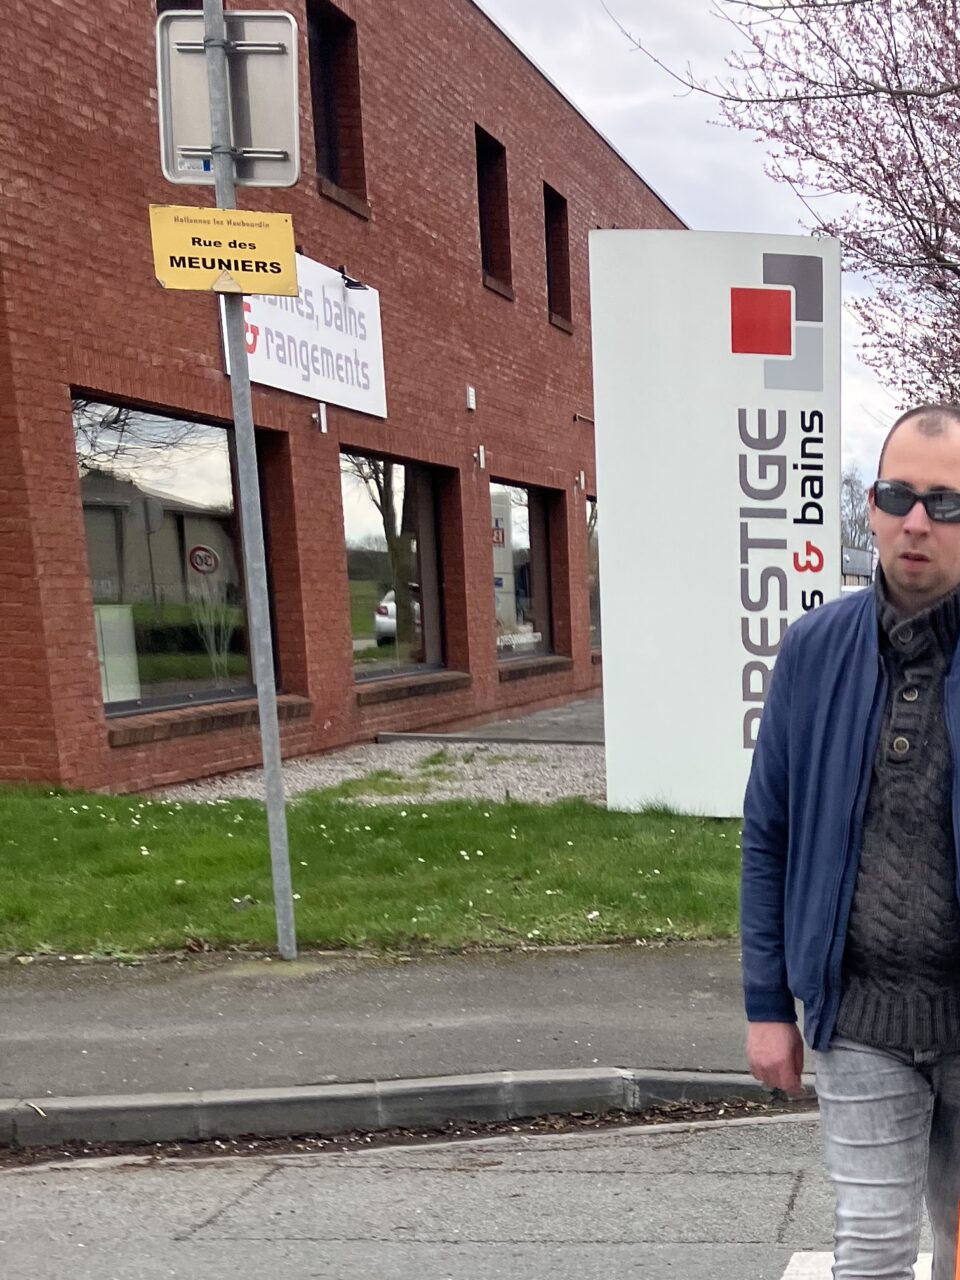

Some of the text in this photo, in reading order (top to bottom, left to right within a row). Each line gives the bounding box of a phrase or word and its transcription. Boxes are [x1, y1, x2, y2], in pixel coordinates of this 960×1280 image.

[169, 255, 282, 274] MEUNIERS
[191, 237, 257, 250] Rue des
[322, 285, 367, 341] bains
[264, 326, 370, 390] rangements
[793, 409, 824, 525] bains
[793, 541, 824, 573] &
